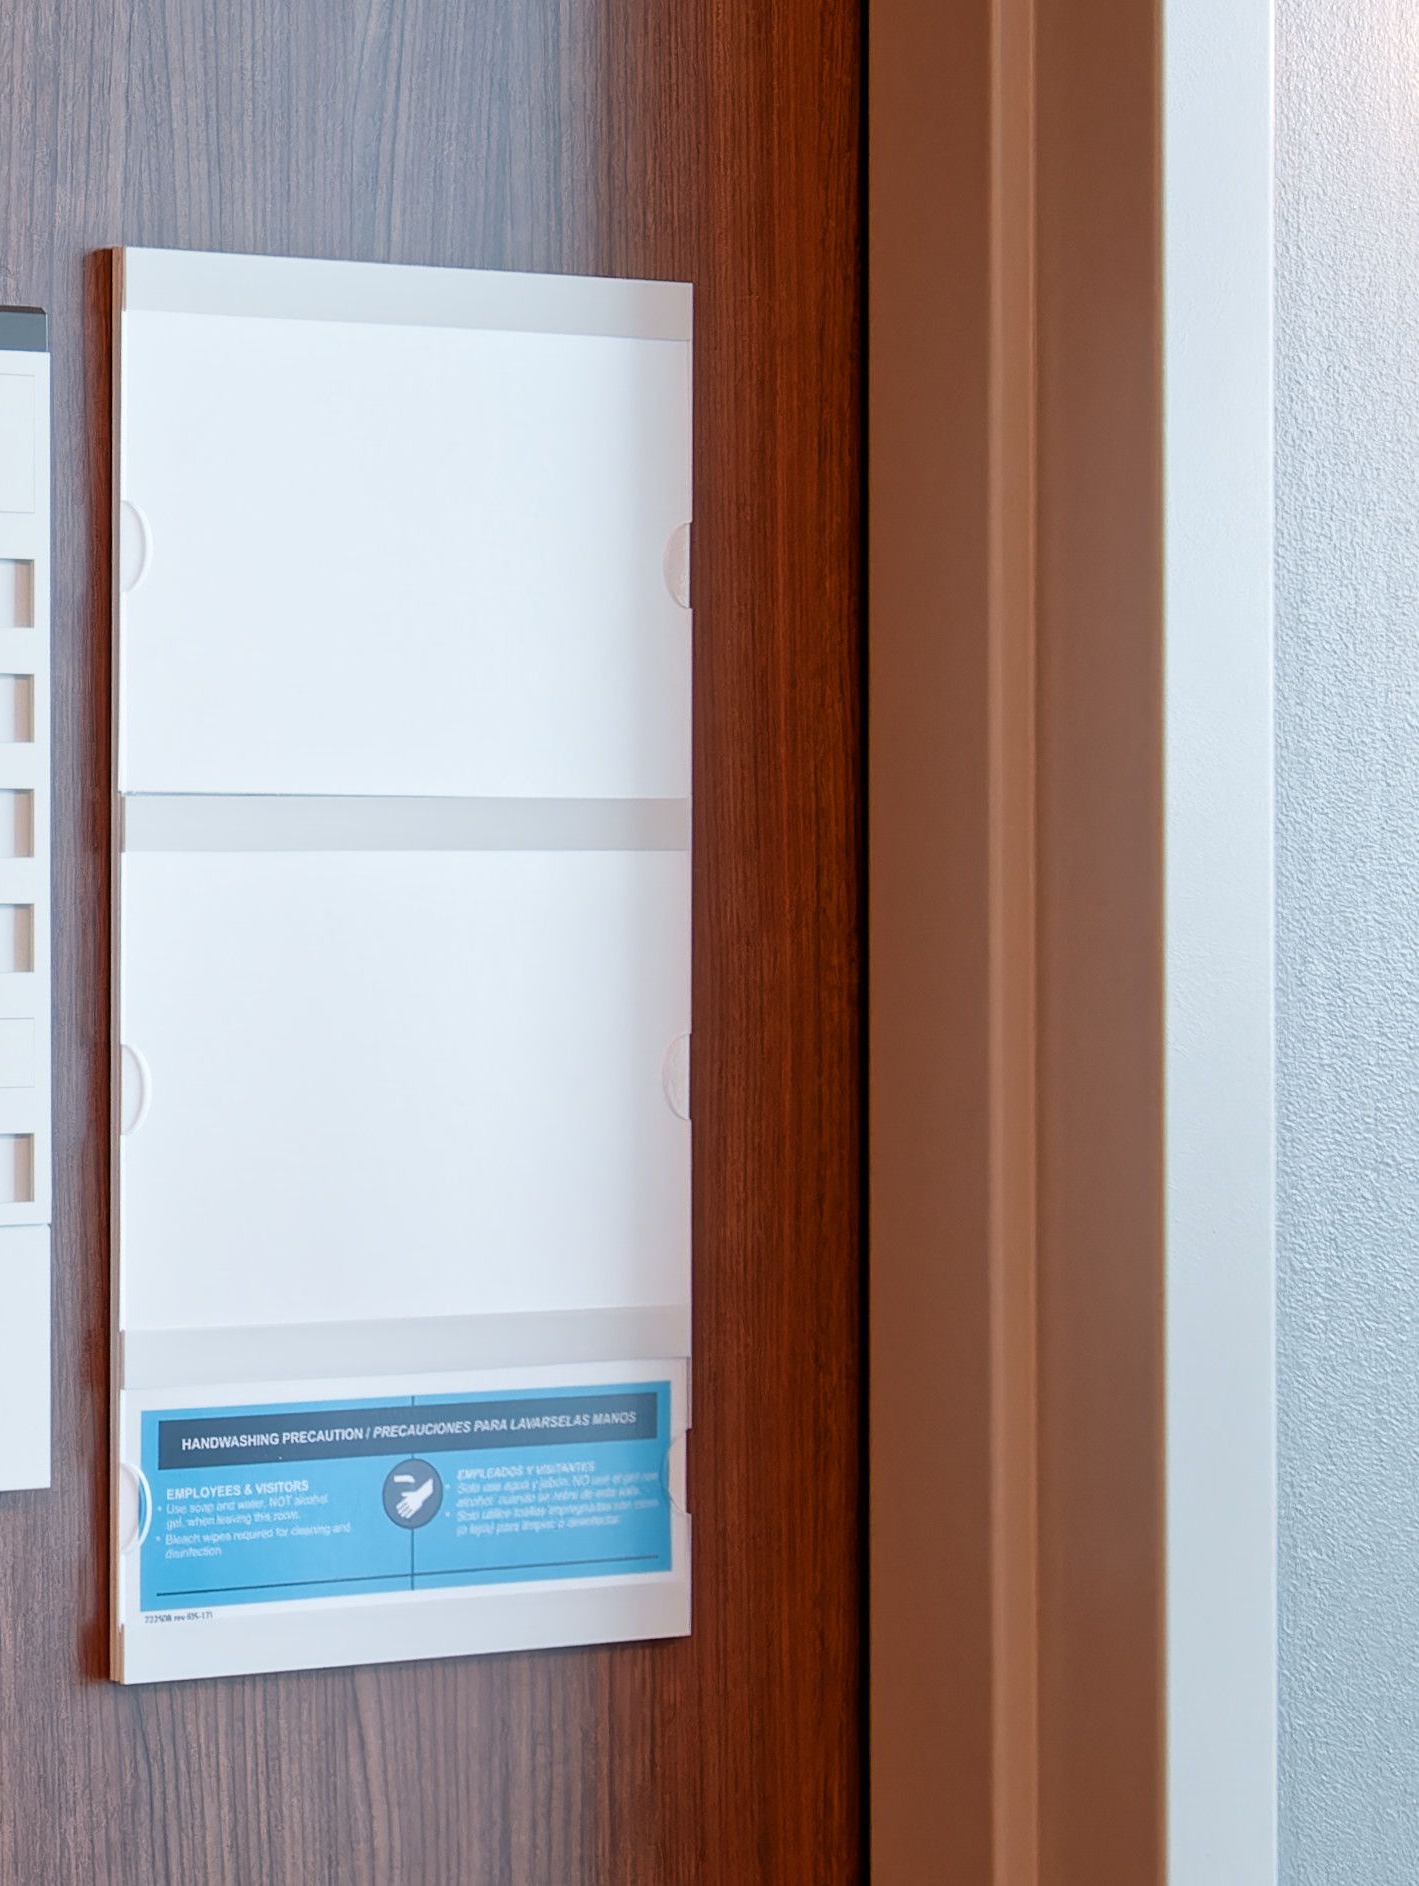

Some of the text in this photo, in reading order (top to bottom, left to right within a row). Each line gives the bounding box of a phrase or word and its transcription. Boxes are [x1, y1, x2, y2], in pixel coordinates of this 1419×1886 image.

[181, 1433, 280, 1451] HANDWASHING
[282, 1427, 364, 1445] PRECAUTION
[373, 1420, 472, 1438] PRECAUCIONES
[474, 1418, 508, 1432] PARA
[592, 1410, 637, 1425] MANOS
[166, 1479, 309, 1500] EMPLOYEES & VISITORS
[269, 1494, 293, 1507] NOT
